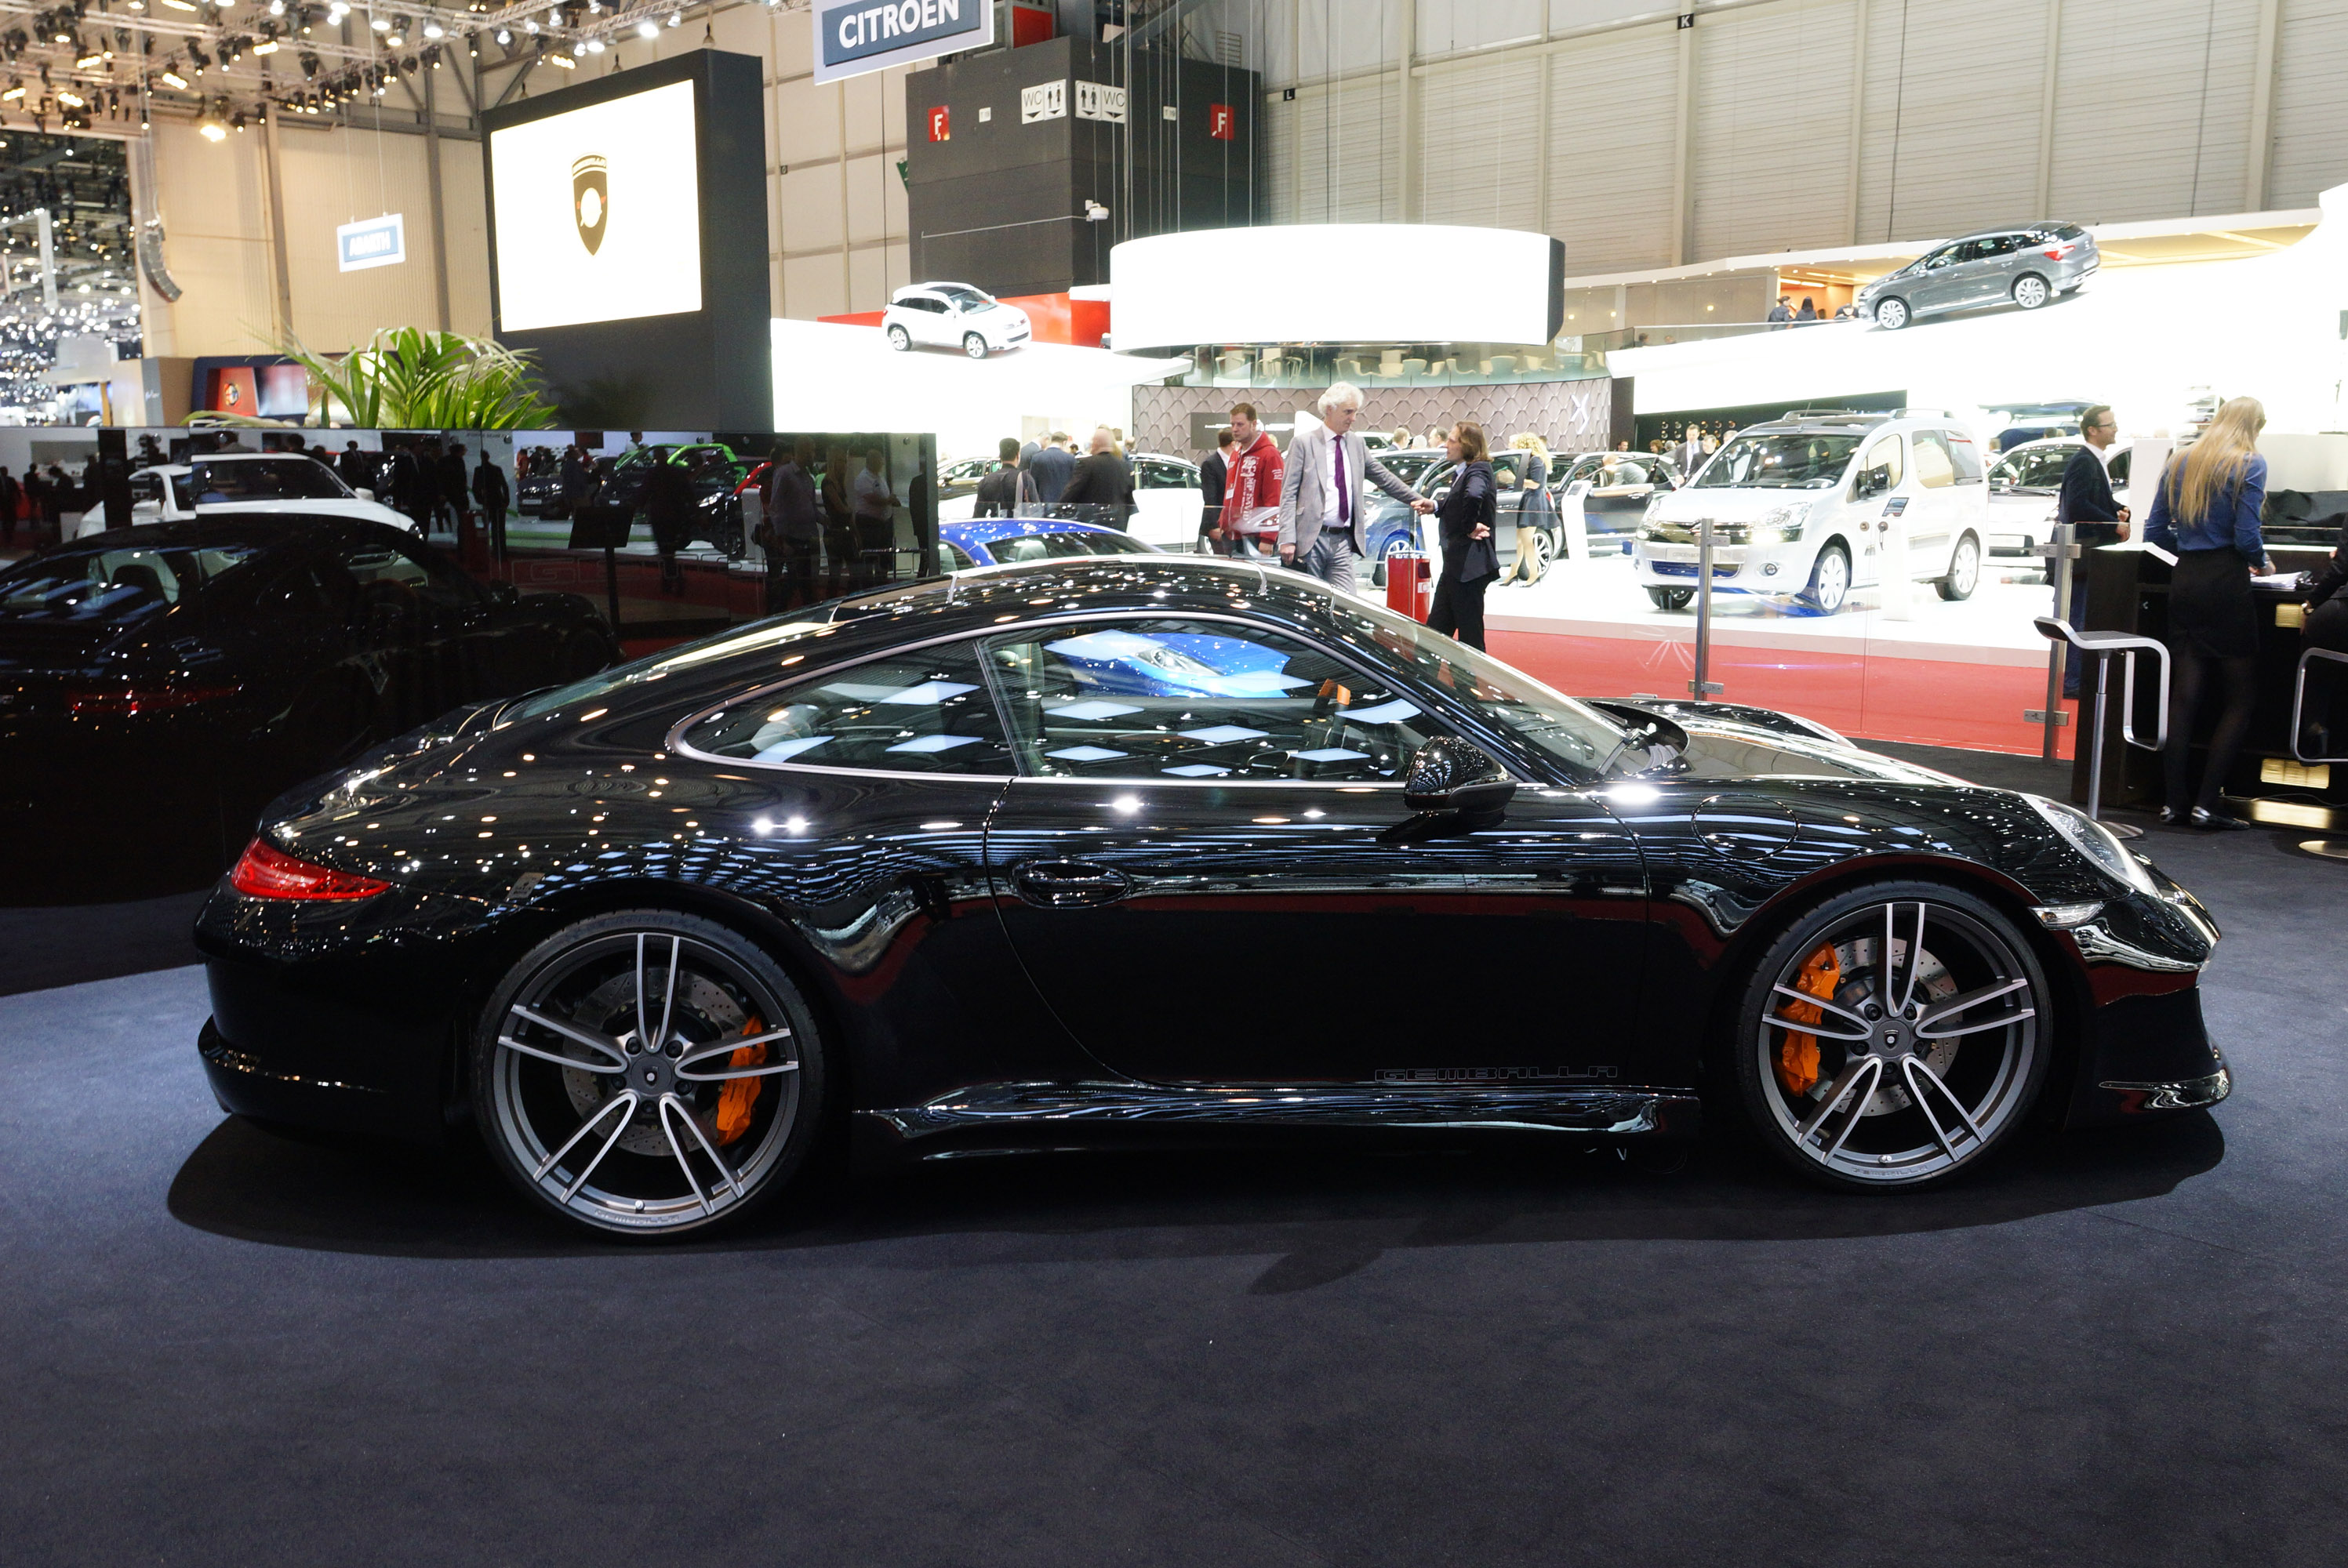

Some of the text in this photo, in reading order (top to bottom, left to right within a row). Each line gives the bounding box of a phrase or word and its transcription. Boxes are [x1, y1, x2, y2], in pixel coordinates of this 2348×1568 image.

[1681, 15, 1690, 27] K
[1023, 89, 1042, 107] WC
[1103, 92, 1125, 108] WC
[1286, 90, 1292, 100] L
[1375, 1065, 1618, 1082] GEMBALLA
